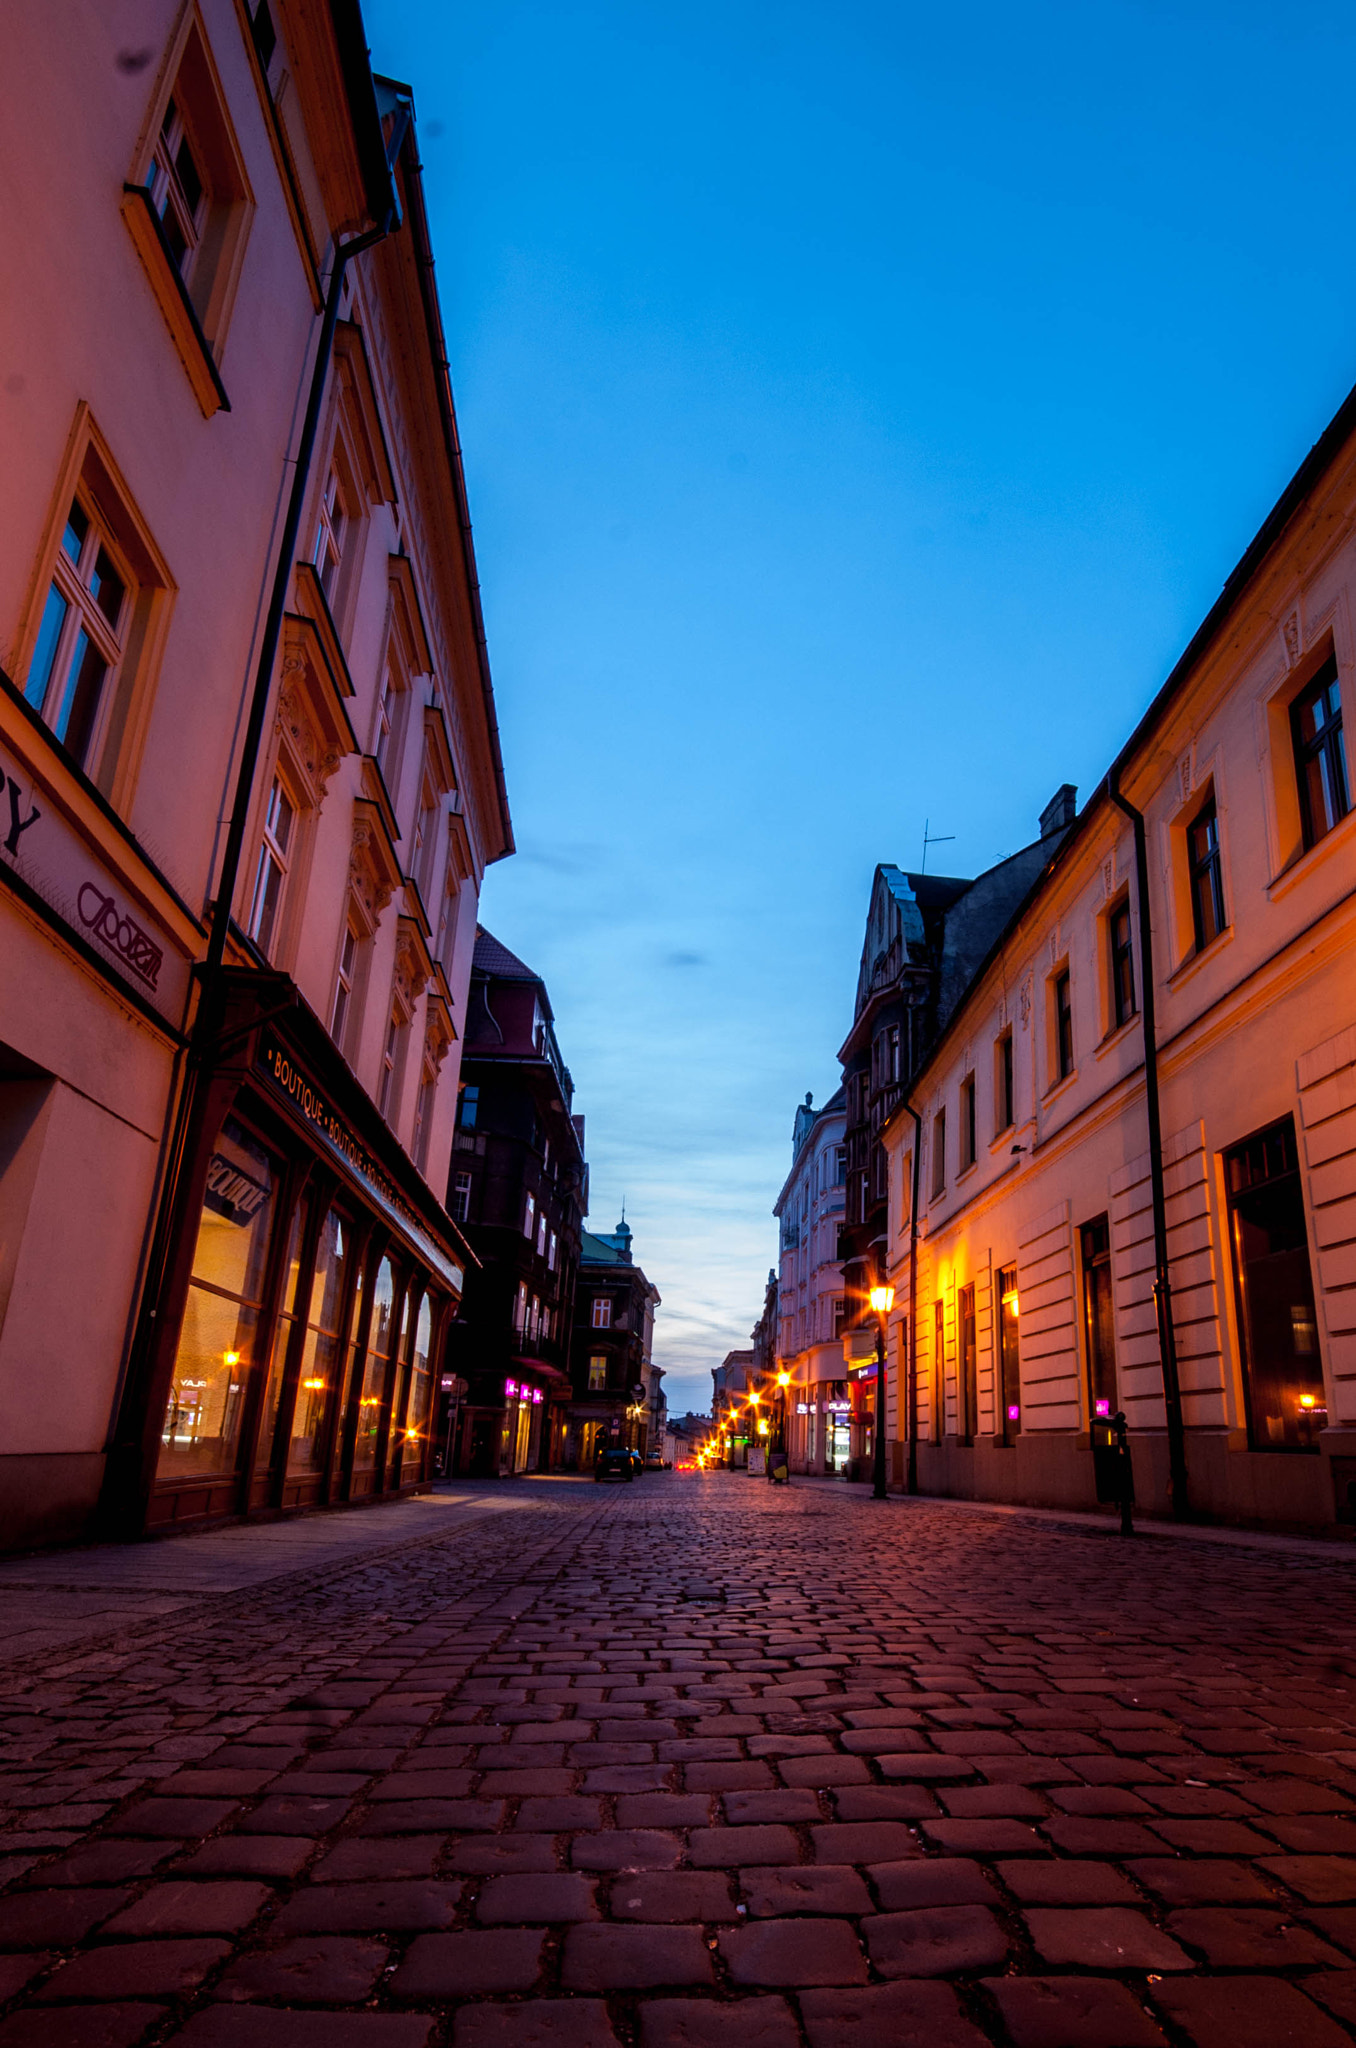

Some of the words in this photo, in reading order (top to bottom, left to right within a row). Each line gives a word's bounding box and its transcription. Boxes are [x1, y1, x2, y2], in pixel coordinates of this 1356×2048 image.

[0, 766, 41, 858] Y
[274, 1051, 323, 1126] BOUTIQUE
[328, 1117, 363, 1172] BOUTIQUE
[828, 1402, 851, 1411] PLAY
